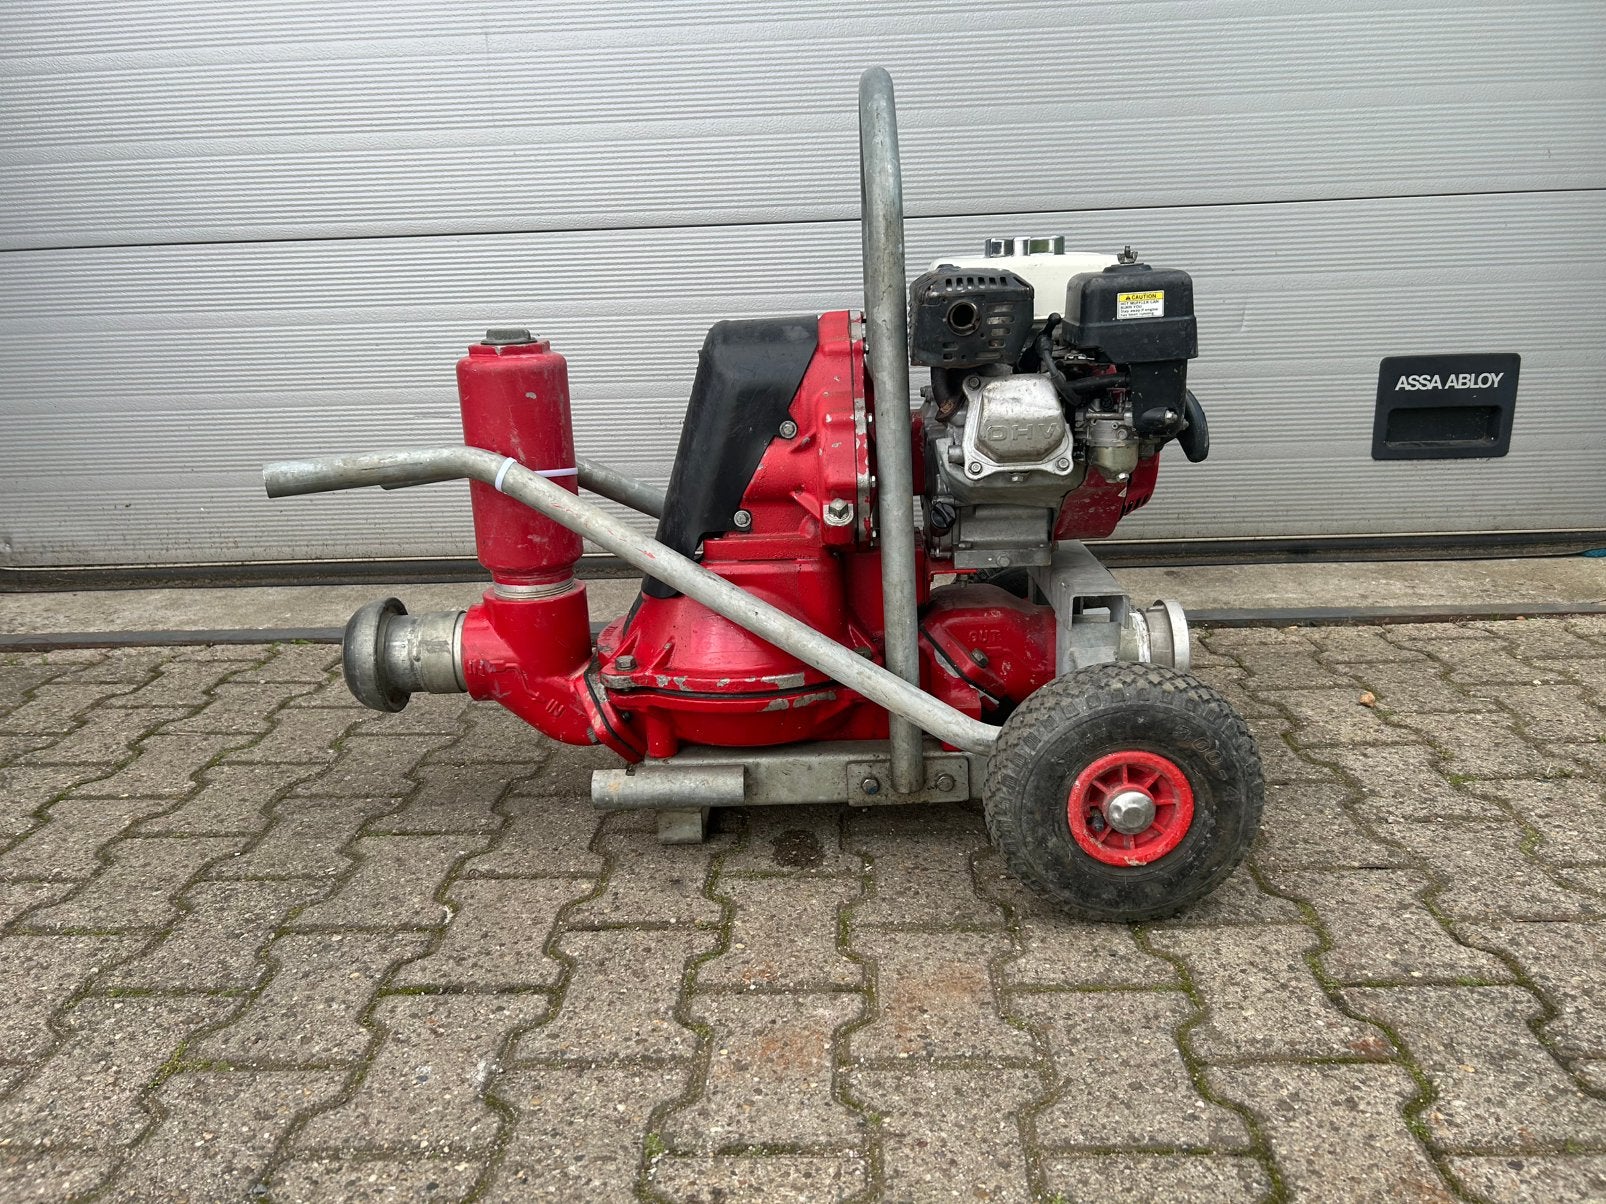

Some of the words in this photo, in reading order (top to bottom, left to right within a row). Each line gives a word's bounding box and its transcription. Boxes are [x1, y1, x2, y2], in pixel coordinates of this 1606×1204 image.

[1394, 374, 1443, 391] ASSA
[1444, 372, 1504, 390] ABLOY
[986, 422, 1057, 441] OHV
